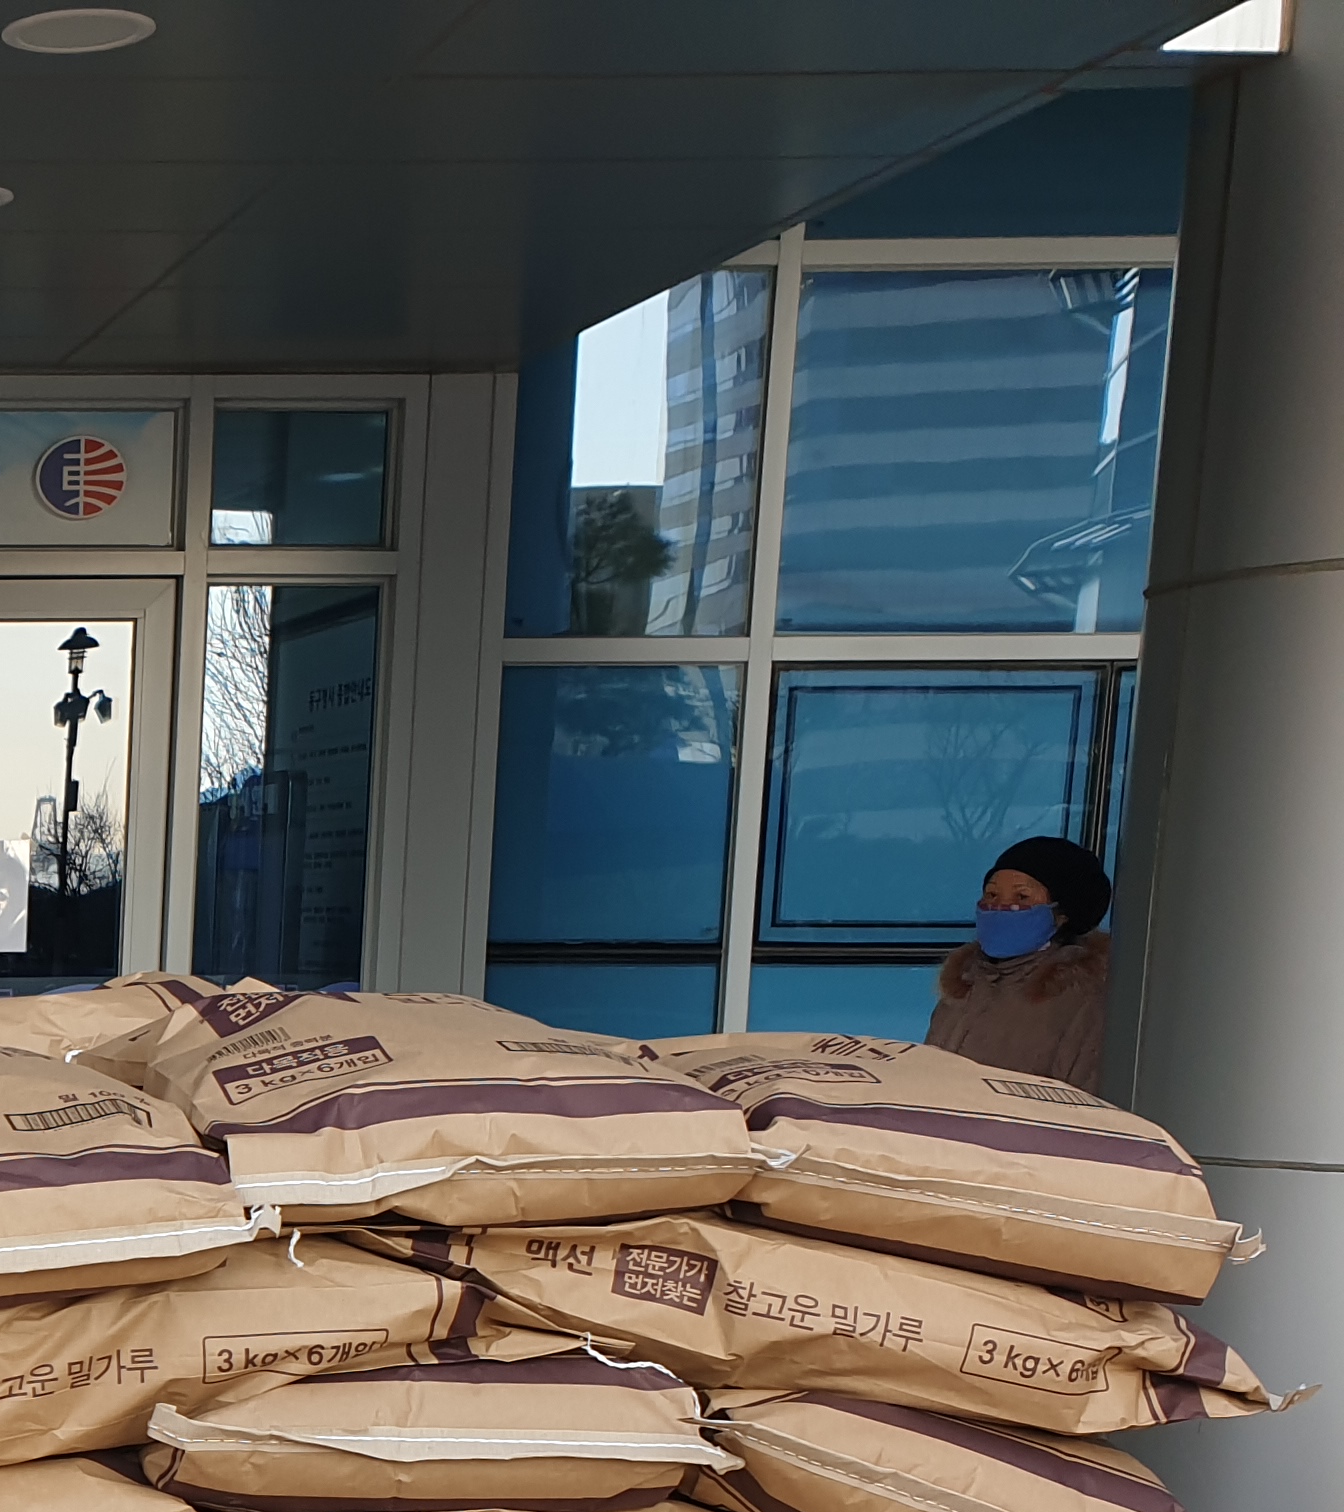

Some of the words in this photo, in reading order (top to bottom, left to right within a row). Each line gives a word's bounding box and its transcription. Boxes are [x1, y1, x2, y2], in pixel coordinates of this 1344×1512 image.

[525, 1239, 597, 1277] 맥선
[624, 1246, 710, 1283] 전문가가
[623, 1271, 704, 1308] 먼저찾는
[722, 1277, 822, 1332] 찰고운
[829, 1303, 925, 1353] 밀가루
[65, 1347, 160, 1387] 밀가루
